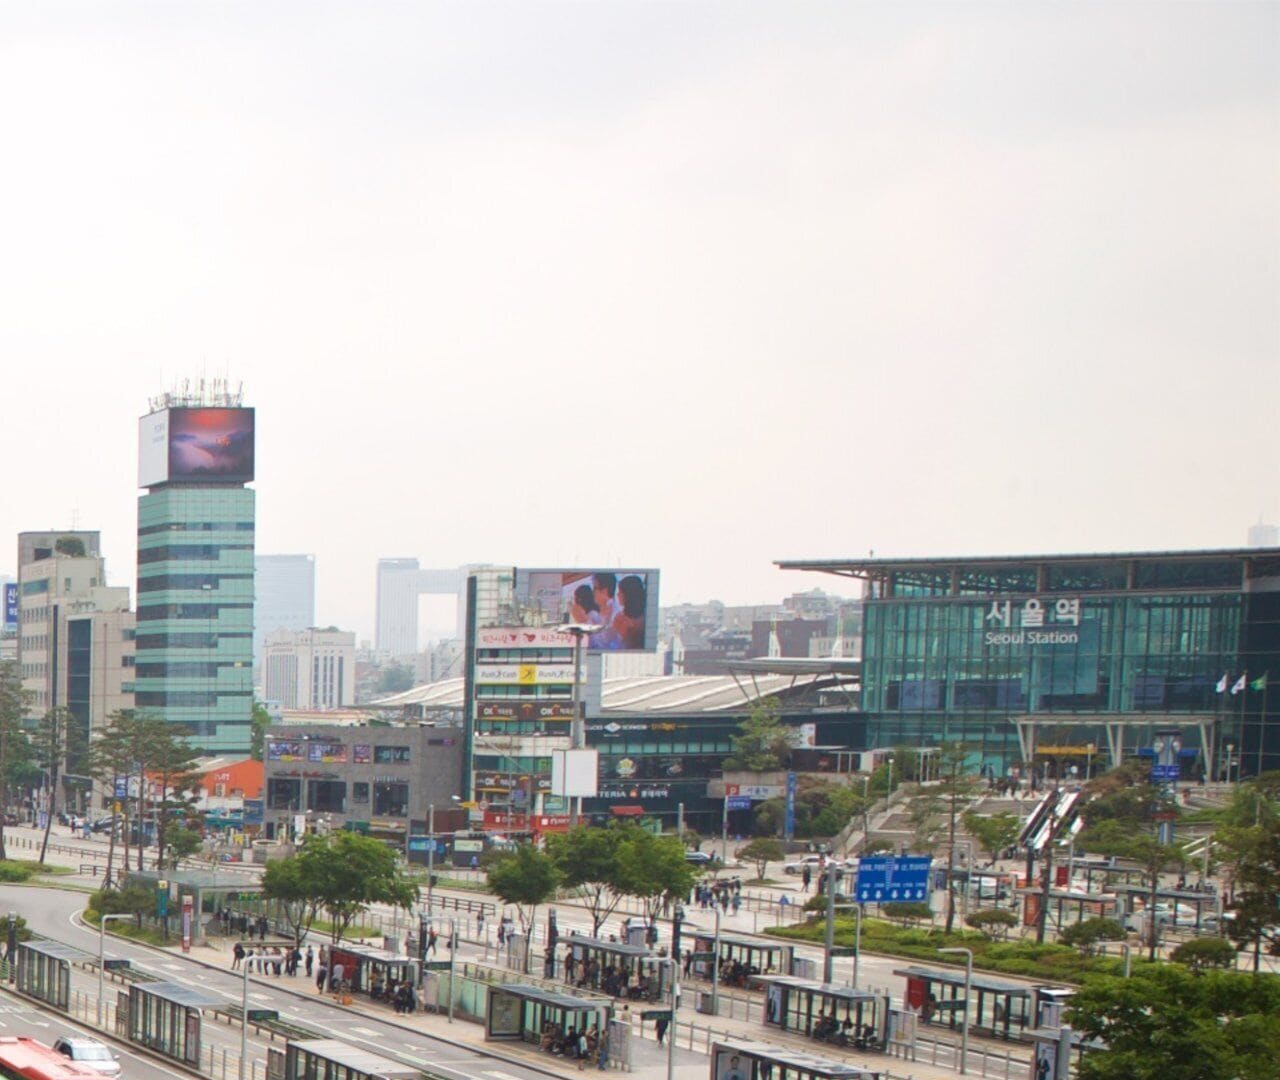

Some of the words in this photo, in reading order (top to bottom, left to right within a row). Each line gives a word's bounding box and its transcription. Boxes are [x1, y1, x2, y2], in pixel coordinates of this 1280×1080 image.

[985, 599, 1079, 627] 서울역
[985, 631, 1024, 645] Seoul
[1027, 631, 1079, 644] Station
